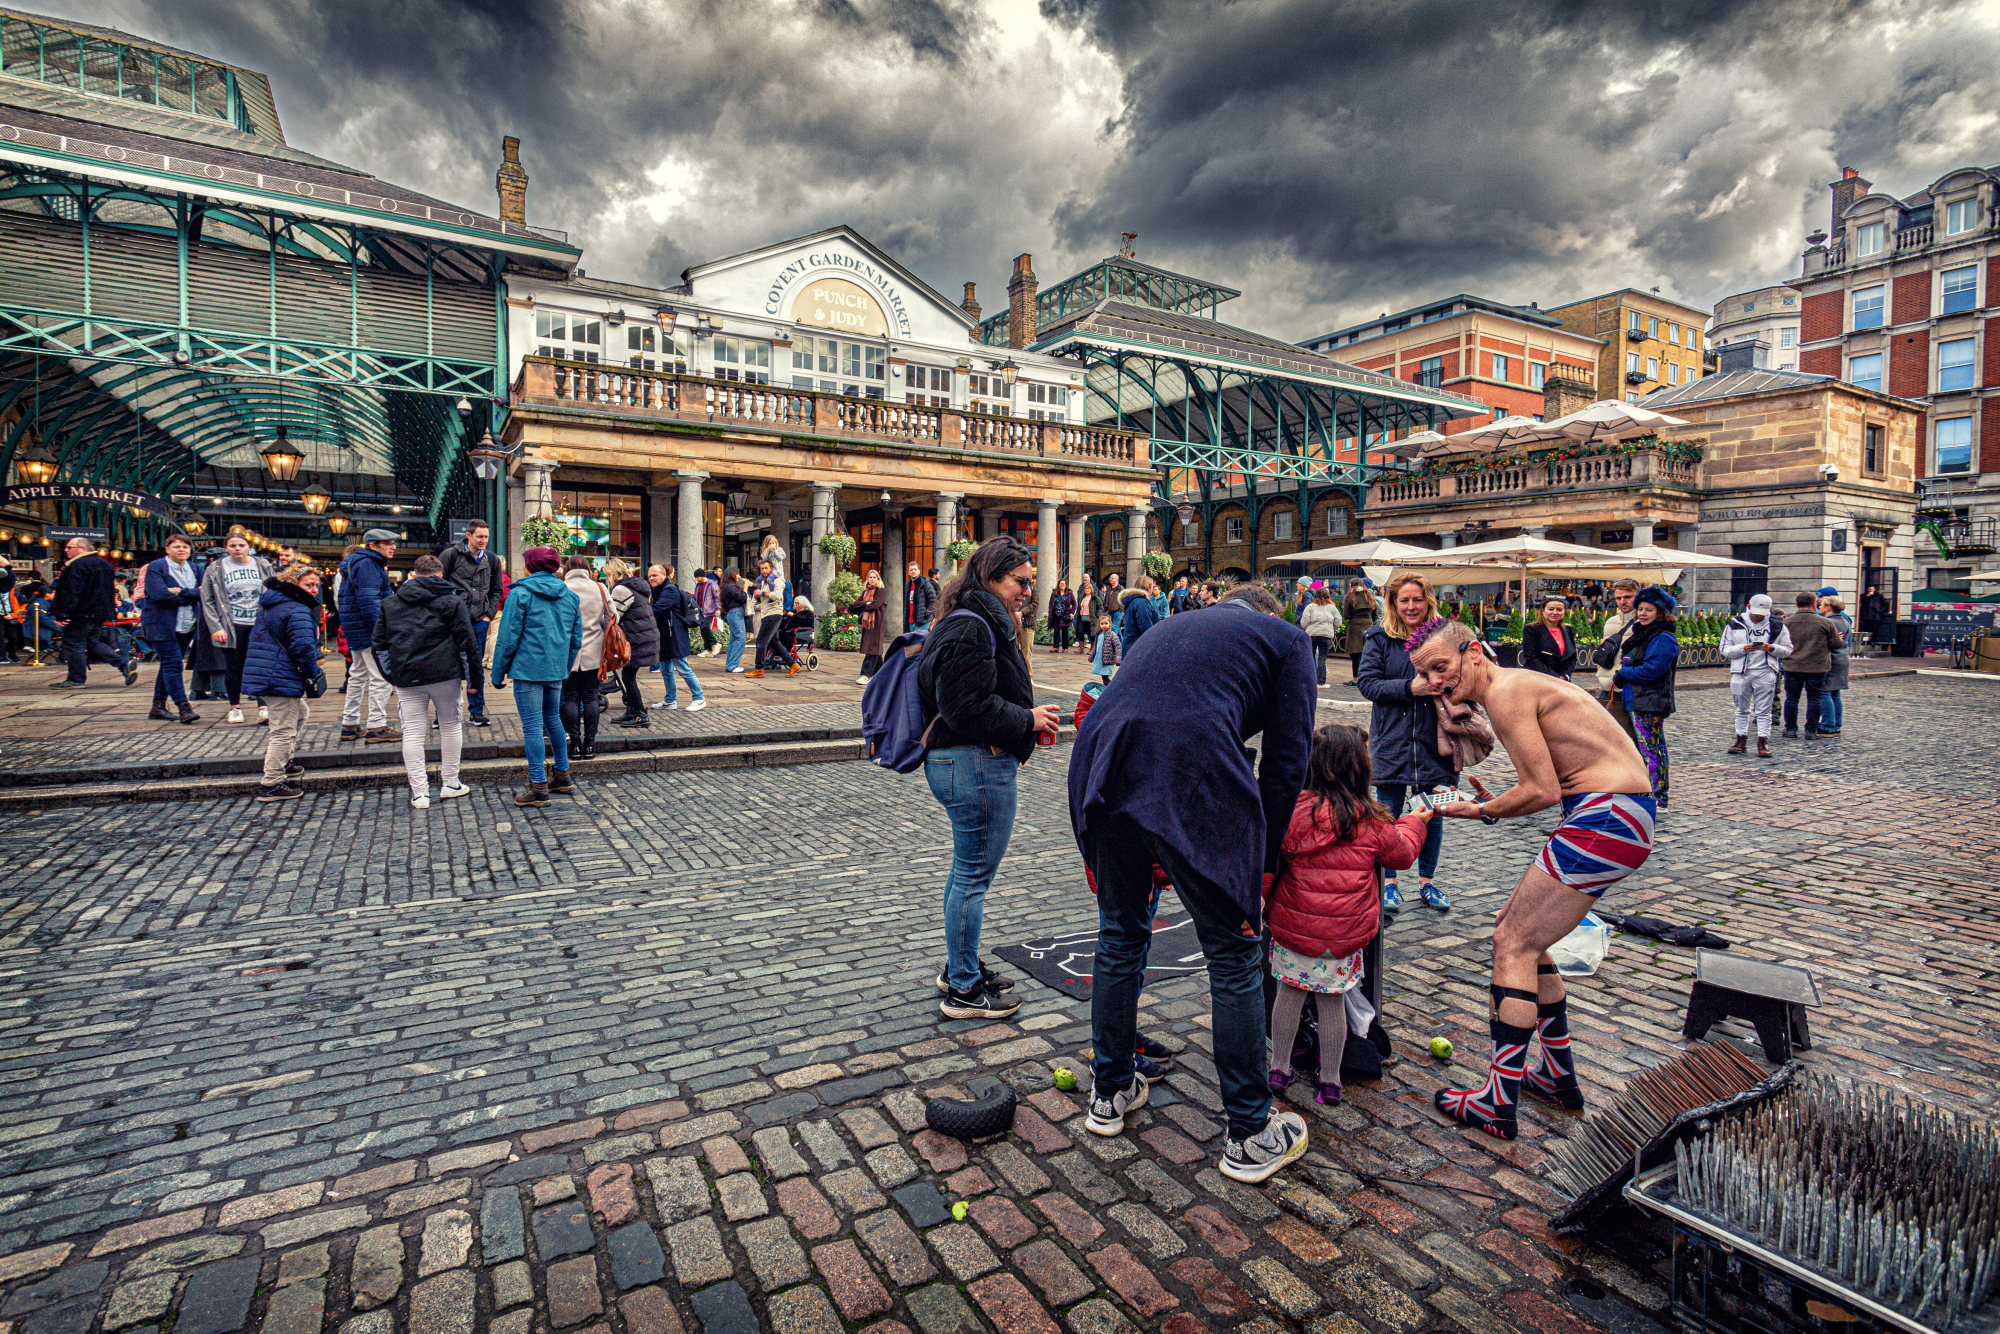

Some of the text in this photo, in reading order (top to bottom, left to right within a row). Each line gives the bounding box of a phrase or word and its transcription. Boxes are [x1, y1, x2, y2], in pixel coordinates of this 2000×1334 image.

[765, 253, 912, 339] COVENT GARDEN MARKET
[813, 288, 868, 310] PUNCH
[814, 308, 868, 328] & JUDY
[8, 486, 146, 506] APPLE MARKET
[725, 507, 771, 517] CENTRAL
